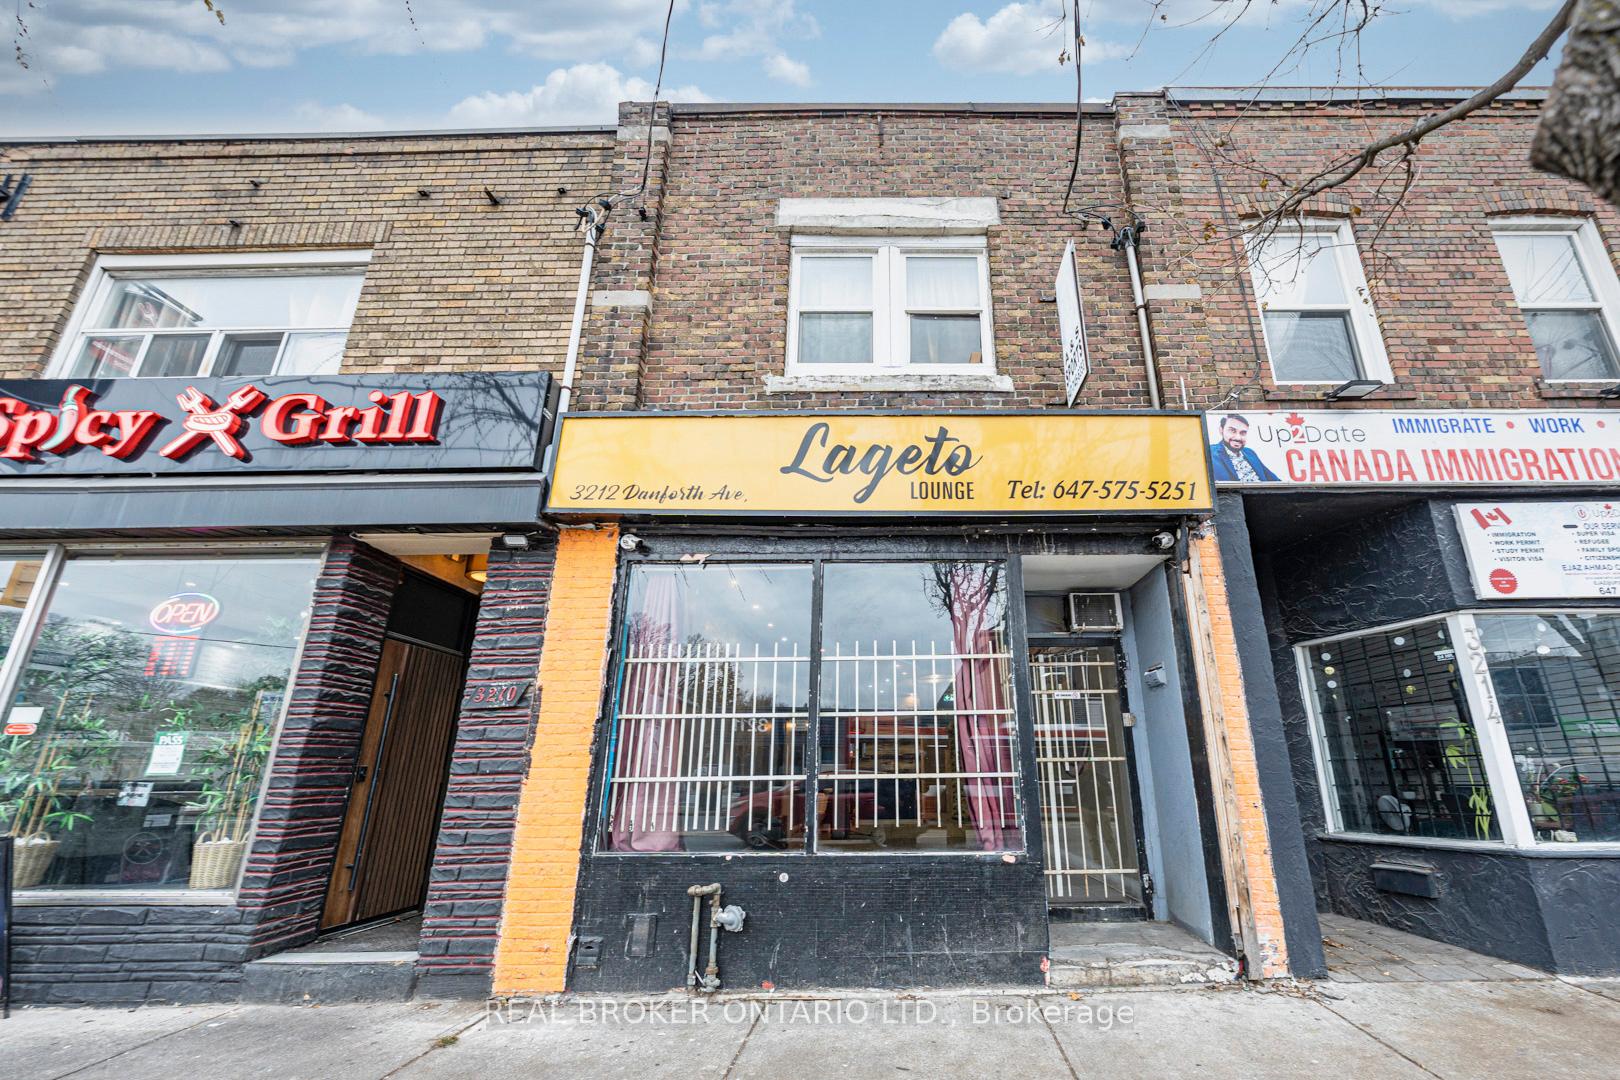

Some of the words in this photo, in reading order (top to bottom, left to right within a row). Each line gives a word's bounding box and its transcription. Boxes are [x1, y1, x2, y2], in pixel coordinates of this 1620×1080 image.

[260, 390, 445, 445] Grill
[1392, 418, 1495, 433] IMMIGRATE
[1528, 418, 1585, 433] WORK
[779, 422, 984, 504] Lageto
[1285, 449, 1418, 482] CANADA
[569, 484, 620, 501] 3212
[622, 484, 704, 504] Danforth
[910, 481, 975, 500] LOUNGE
[1007, 480, 1046, 499] Tel:
[1053, 480, 1197, 501] 647-575-5251
[154, 602, 215, 624] OPEN
[159, 735, 184, 745] PASS
